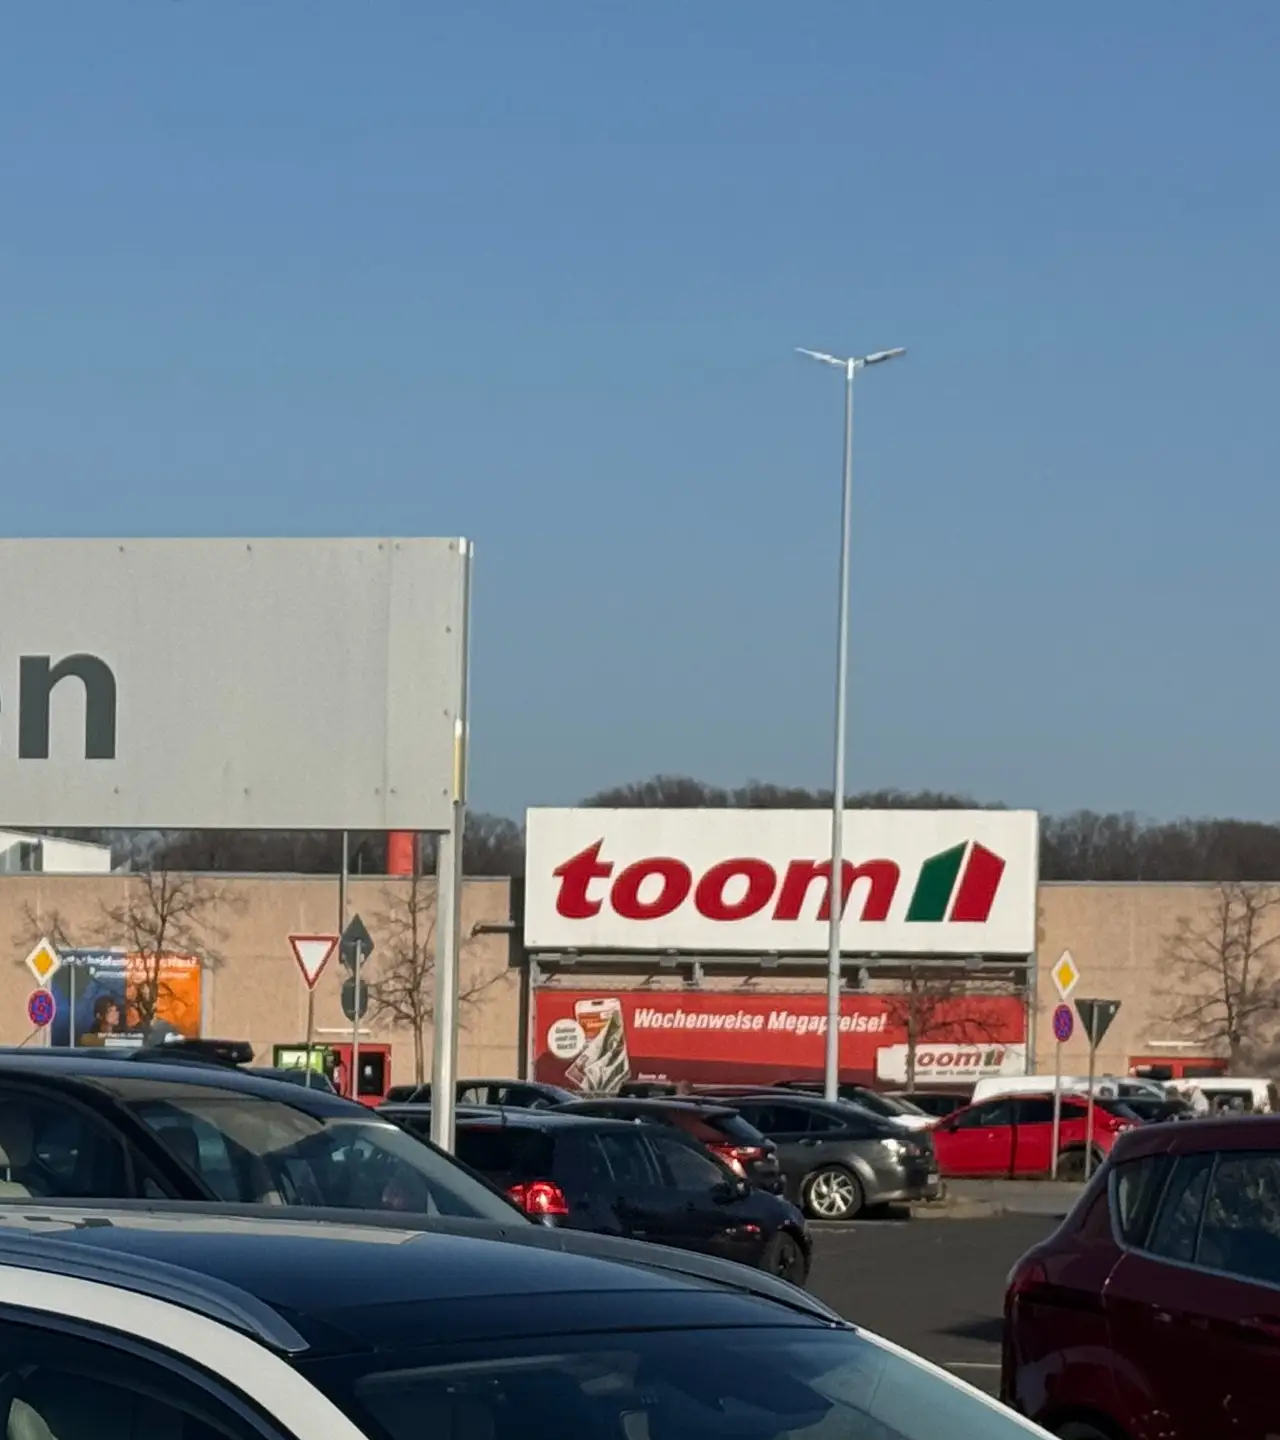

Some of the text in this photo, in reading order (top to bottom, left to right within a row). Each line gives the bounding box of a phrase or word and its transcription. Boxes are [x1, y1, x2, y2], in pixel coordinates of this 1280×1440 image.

[552, 837, 900, 922] toom
[633, 1008, 887, 1036] Wochenweise Megapeise!
[907, 1050, 981, 1067] oom
